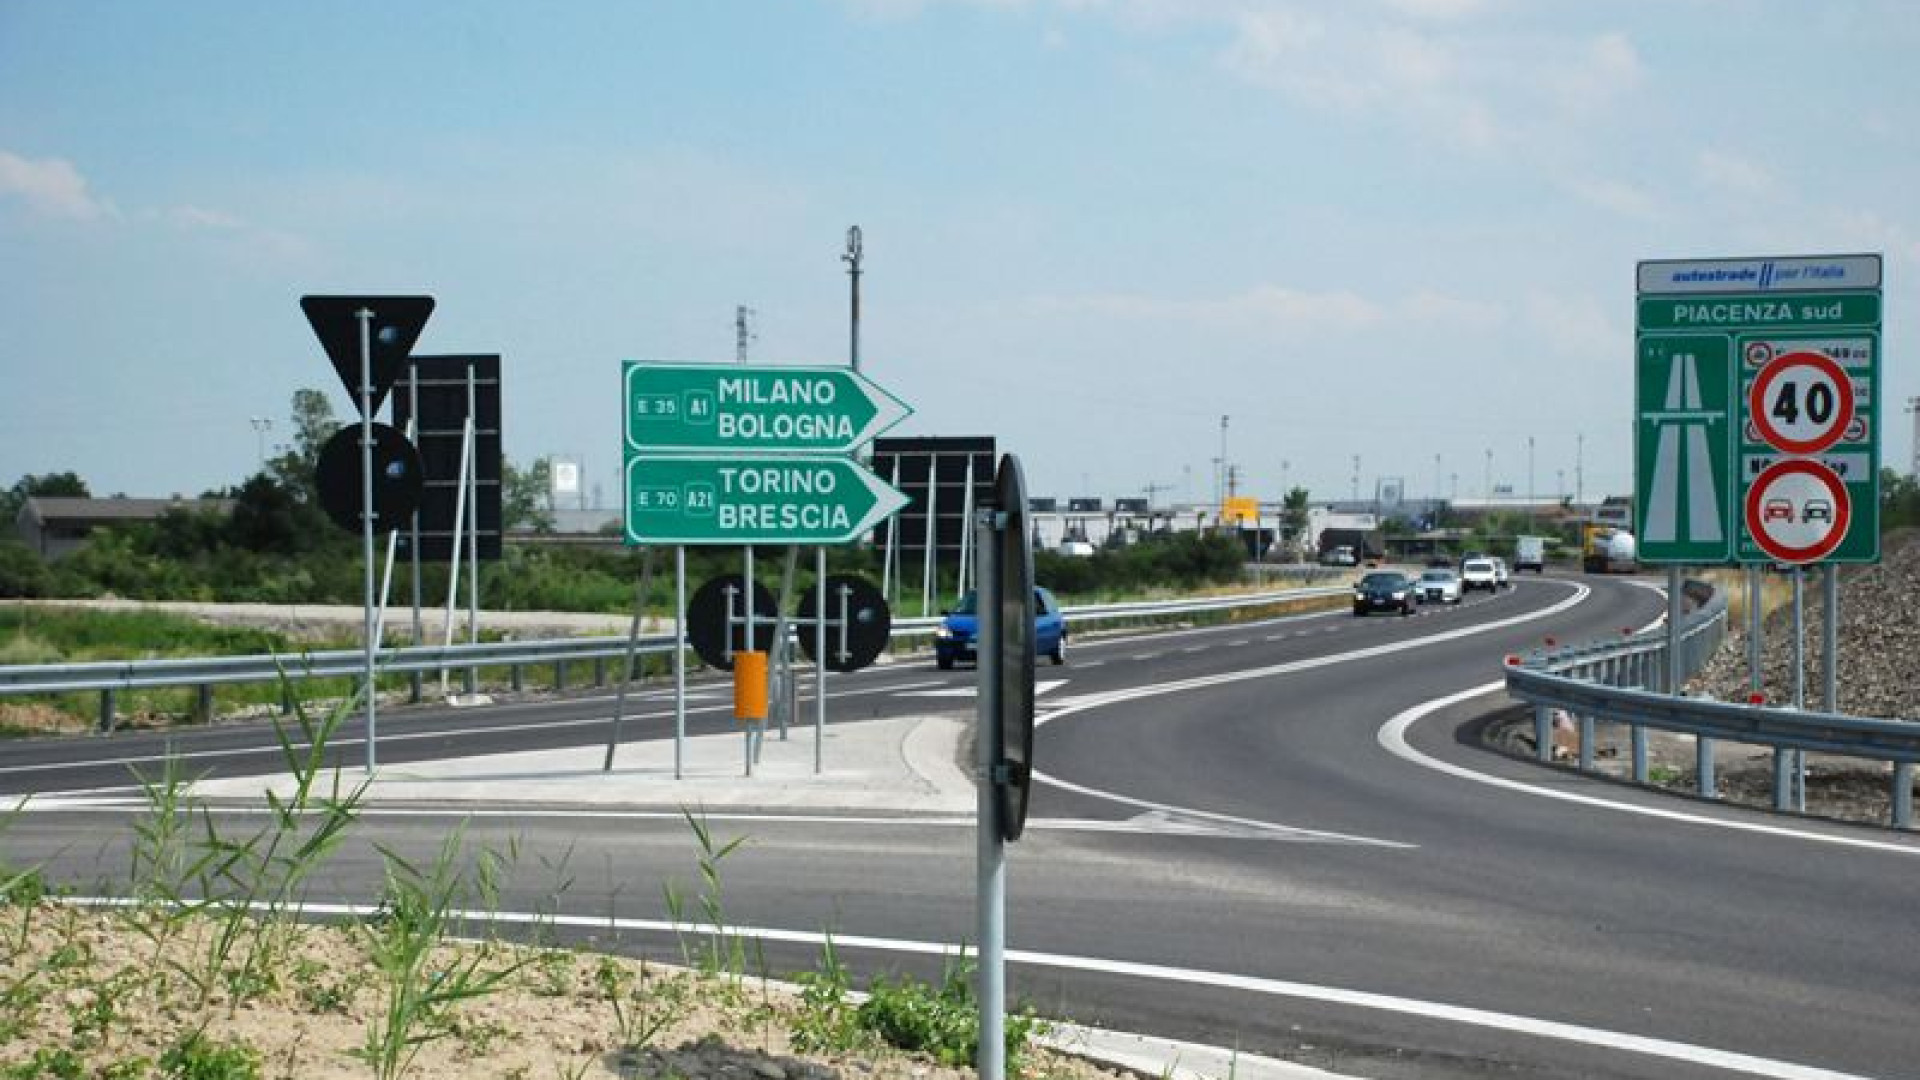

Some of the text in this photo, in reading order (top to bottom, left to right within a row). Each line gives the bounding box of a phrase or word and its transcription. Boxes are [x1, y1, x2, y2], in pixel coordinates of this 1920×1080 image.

[1673, 301, 1843, 323] PIACENZA sud
[718, 378, 836, 405] MILANO
[1772, 381, 1834, 426] 40
[637, 399, 649, 415] E
[690, 398, 708, 416] A1
[717, 412, 854, 439] BOLOGNA
[717, 467, 837, 494] TORINO
[639, 490, 677, 506] E 70
[687, 490, 714, 507] A21
[718, 503, 851, 530] BRESCIA
